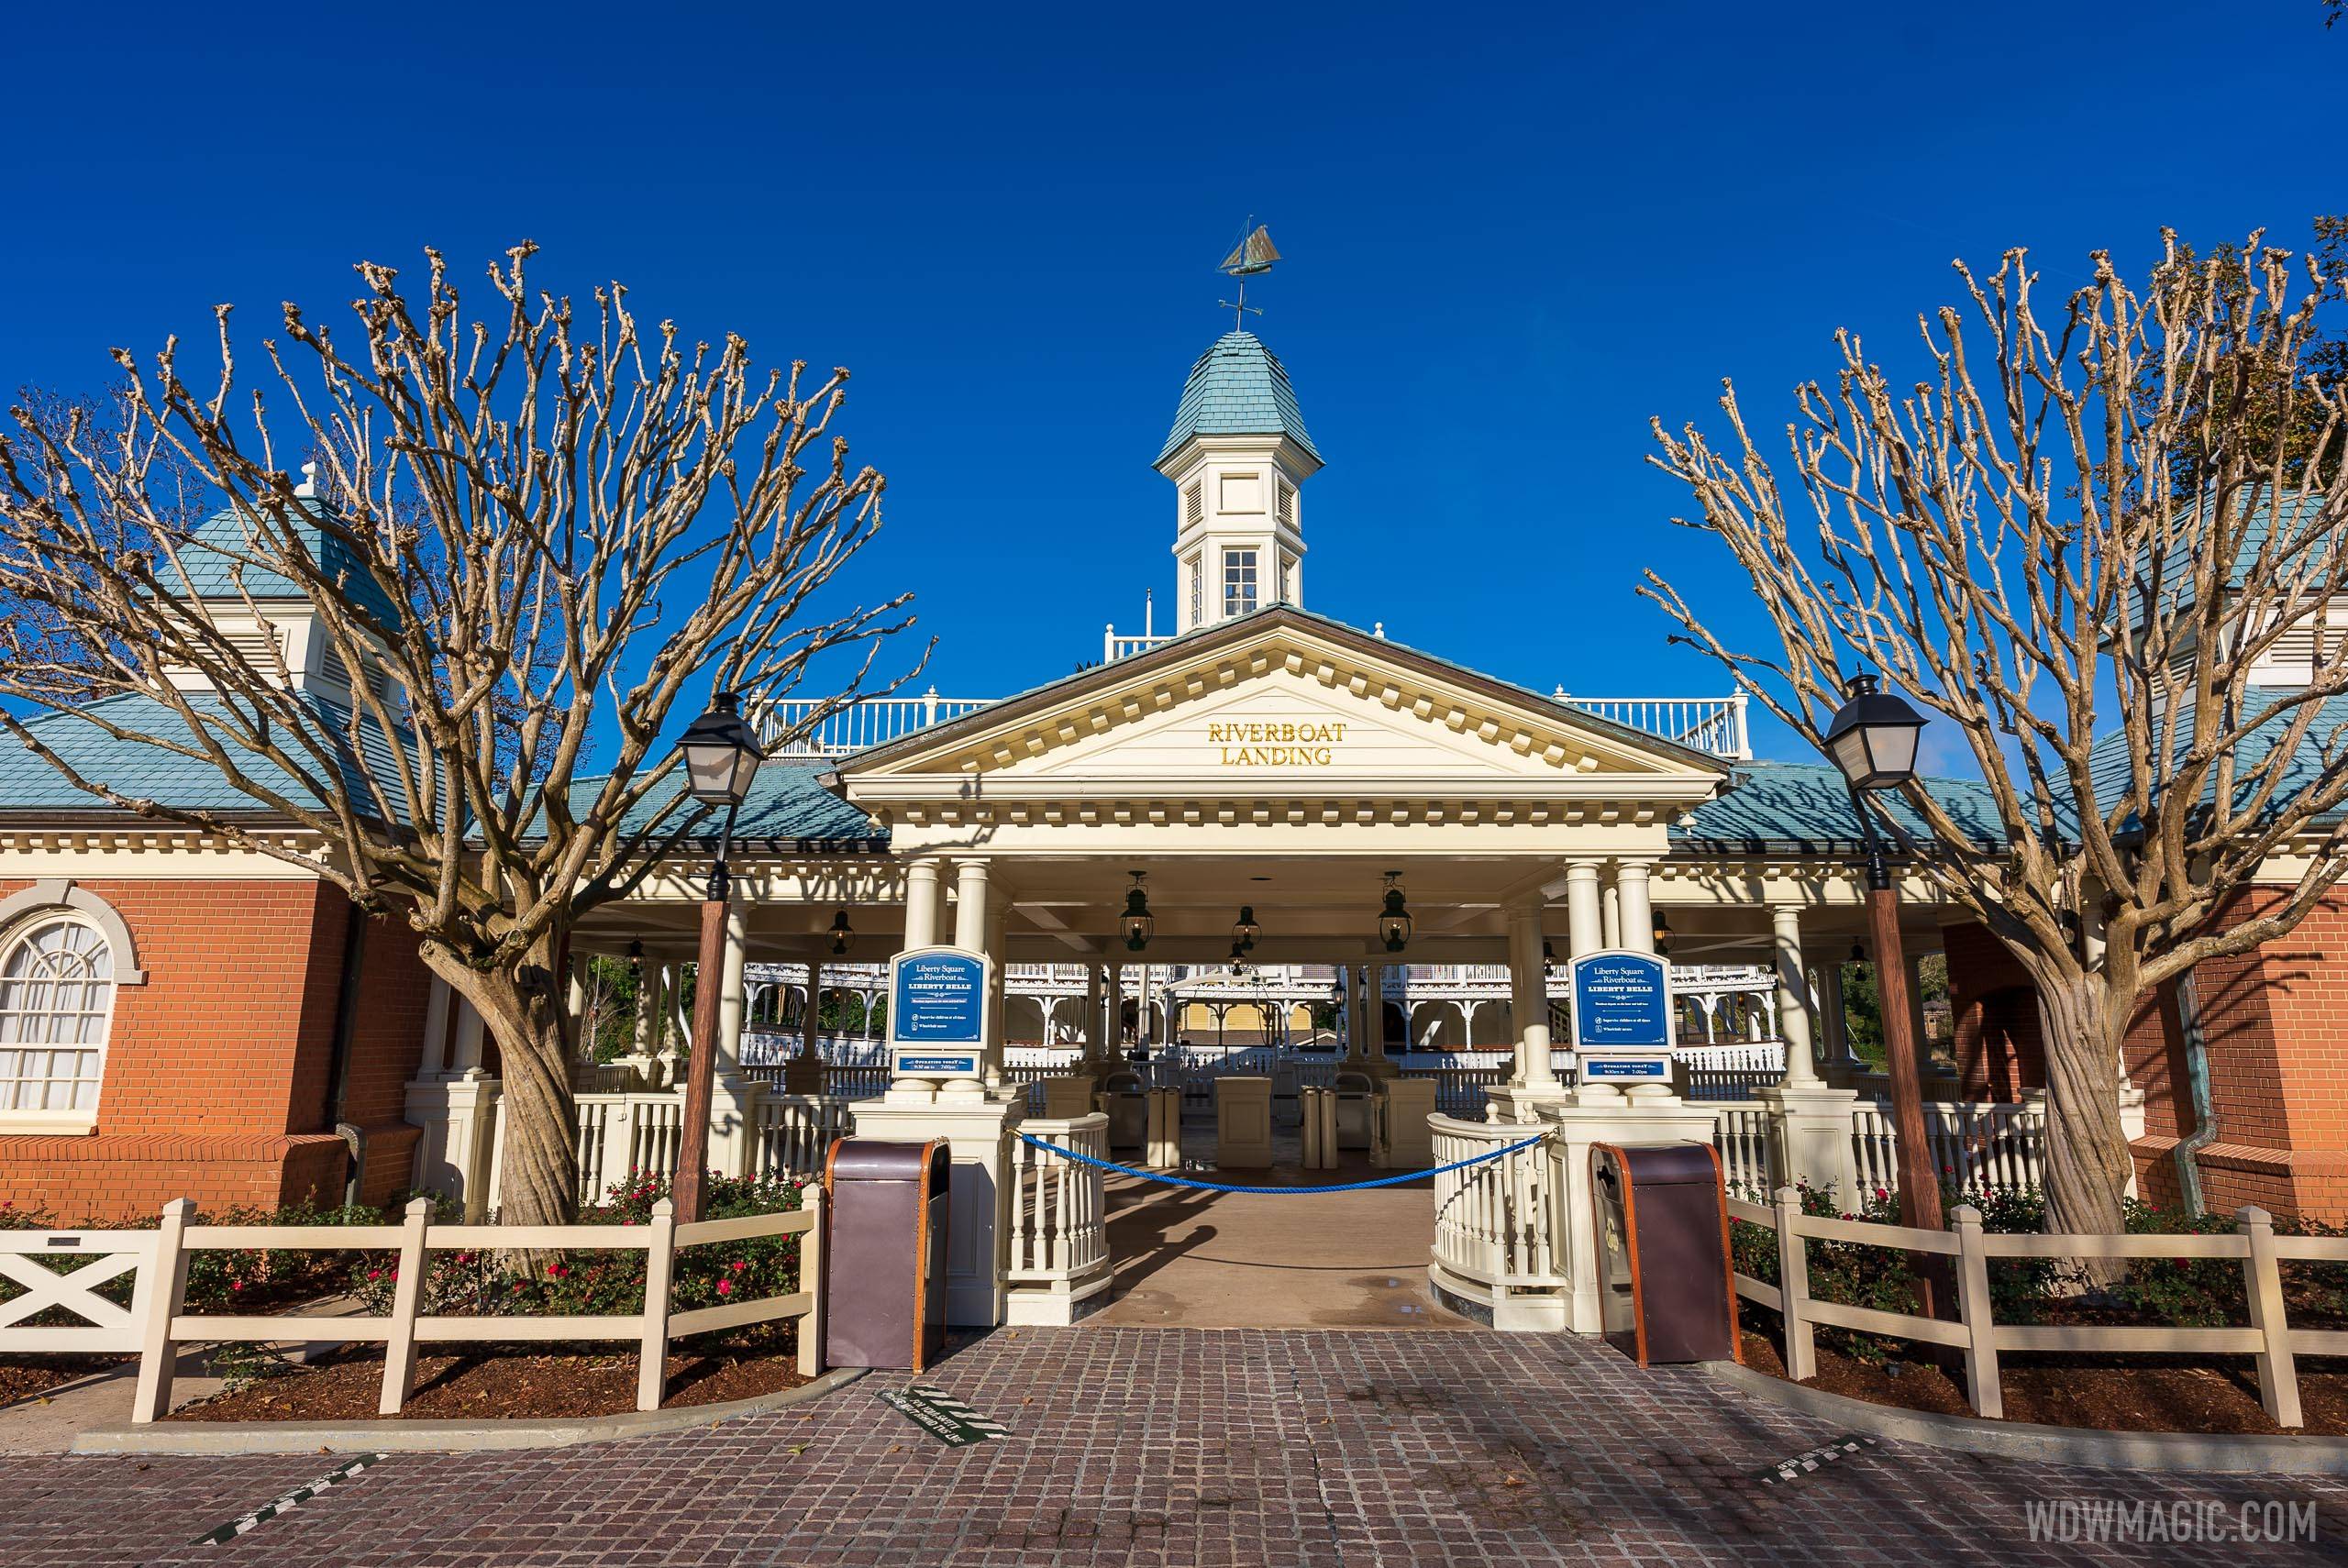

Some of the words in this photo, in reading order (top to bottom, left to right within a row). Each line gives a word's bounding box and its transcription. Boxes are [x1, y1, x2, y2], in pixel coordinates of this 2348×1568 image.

[1209, 723, 1346, 742] RIVERBOAT
[1221, 746, 1332, 766] LANDING
[916, 965, 941, 974] Liberty
[941, 965, 965, 974] Square
[1594, 967, 1619, 976] Liberty
[1620, 967, 1645, 976] Square
[924, 973, 957, 981] Riverboat
[936, 1415, 961, 1430] SAFETY
